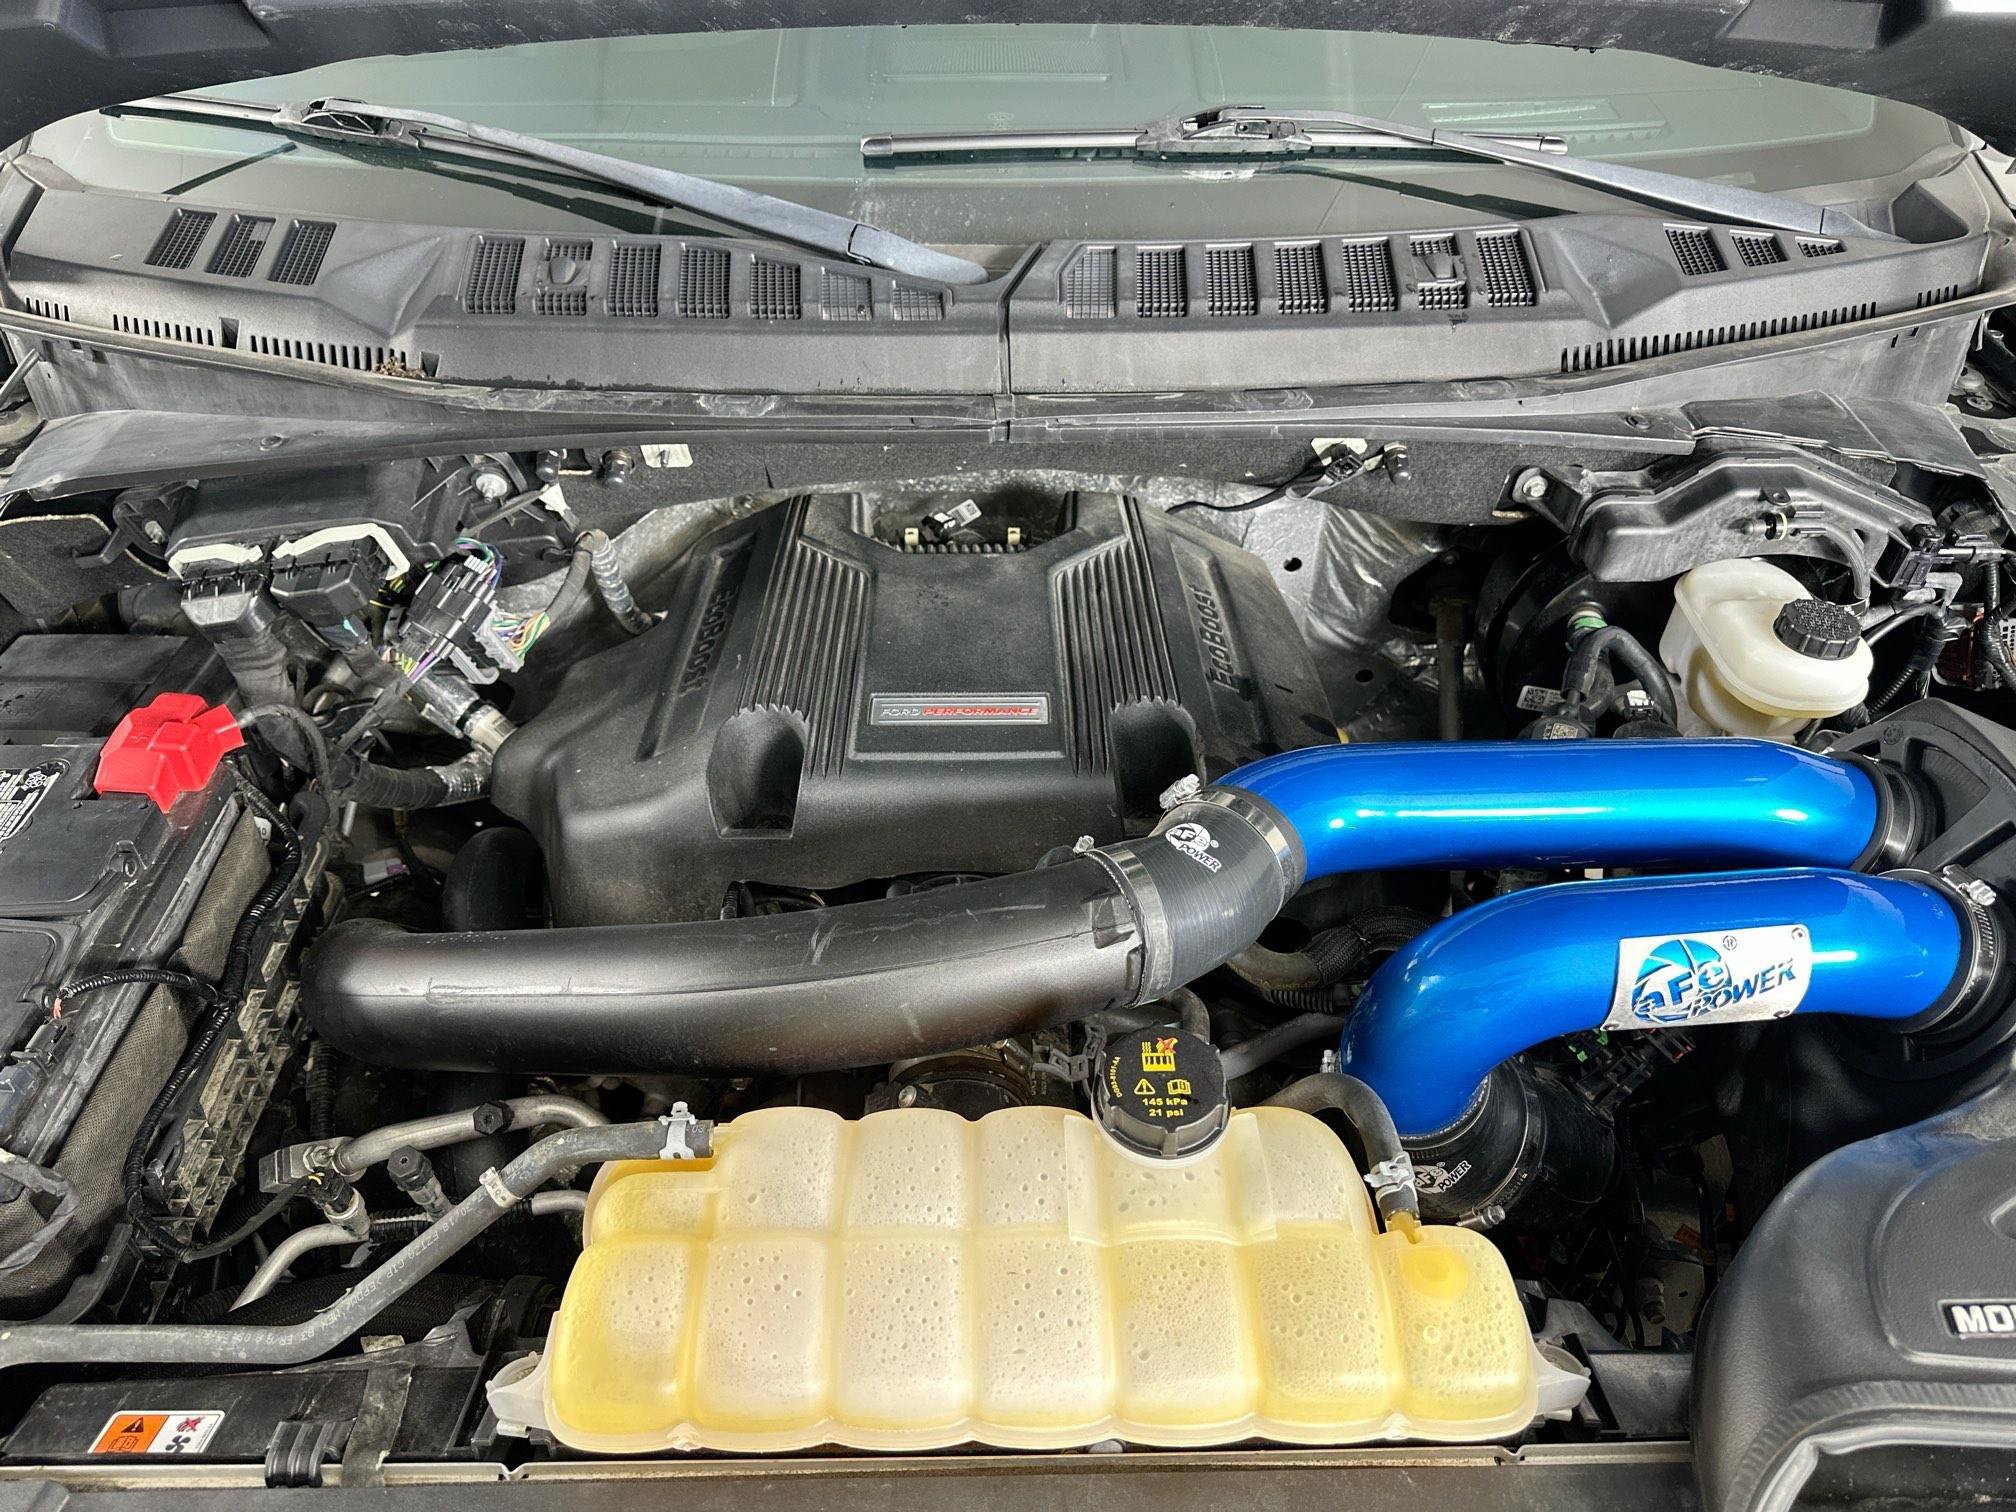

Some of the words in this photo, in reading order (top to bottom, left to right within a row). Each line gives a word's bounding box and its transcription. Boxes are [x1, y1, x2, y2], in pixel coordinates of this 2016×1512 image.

[1187, 584, 1240, 693] EcoBoost
[880, 708, 921, 716] FORD
[922, 706, 1039, 716] PERFORMANCE
[1179, 844, 1220, 872] POWER
[1690, 959, 1796, 1017] POWER
[1142, 1098, 1163, 1106] 145
[1166, 1098, 1188, 1106] kPa
[1149, 1109, 1162, 1117] 21
[1166, 1109, 1184, 1117] psi
[1439, 1161, 1472, 1192] POWER
